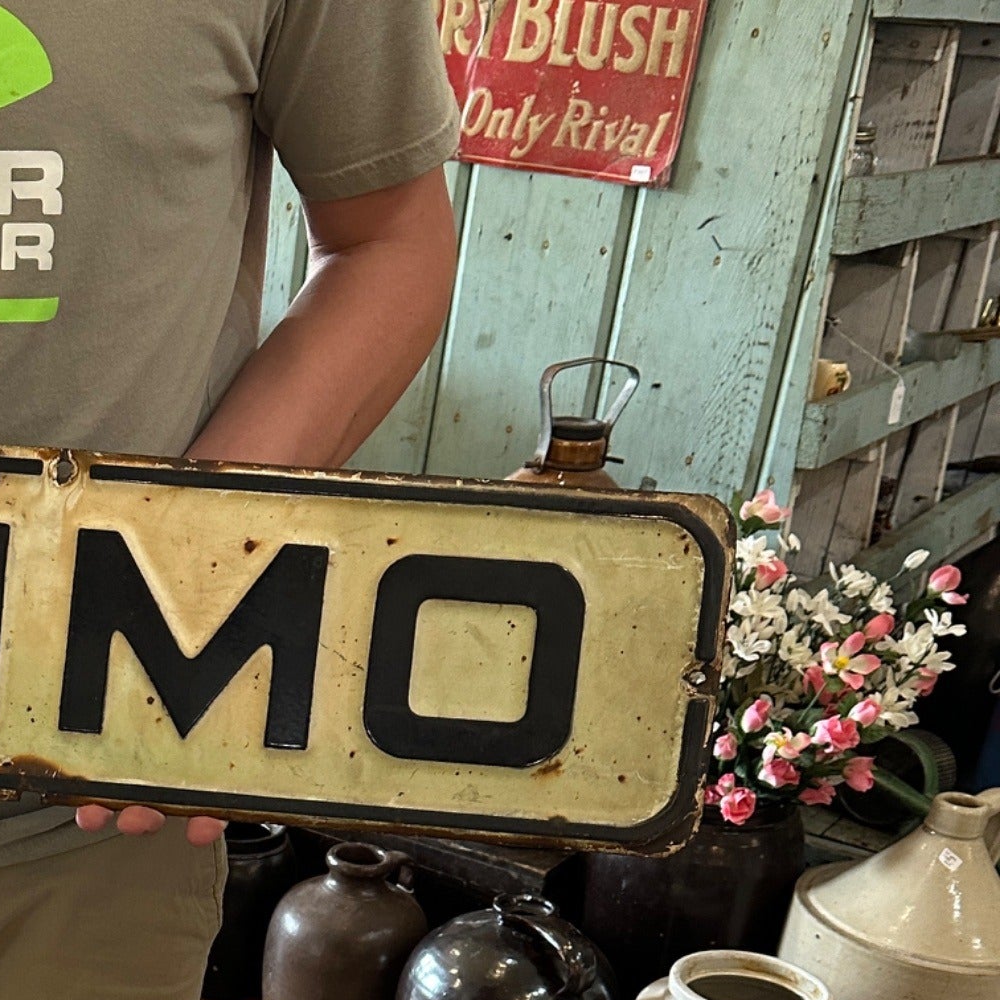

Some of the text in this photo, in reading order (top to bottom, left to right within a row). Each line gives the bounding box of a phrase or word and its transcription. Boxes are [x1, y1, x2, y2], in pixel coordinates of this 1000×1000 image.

[434, 0, 692, 78] RY BLUSH
[462, 87, 672, 159] Only Rival
